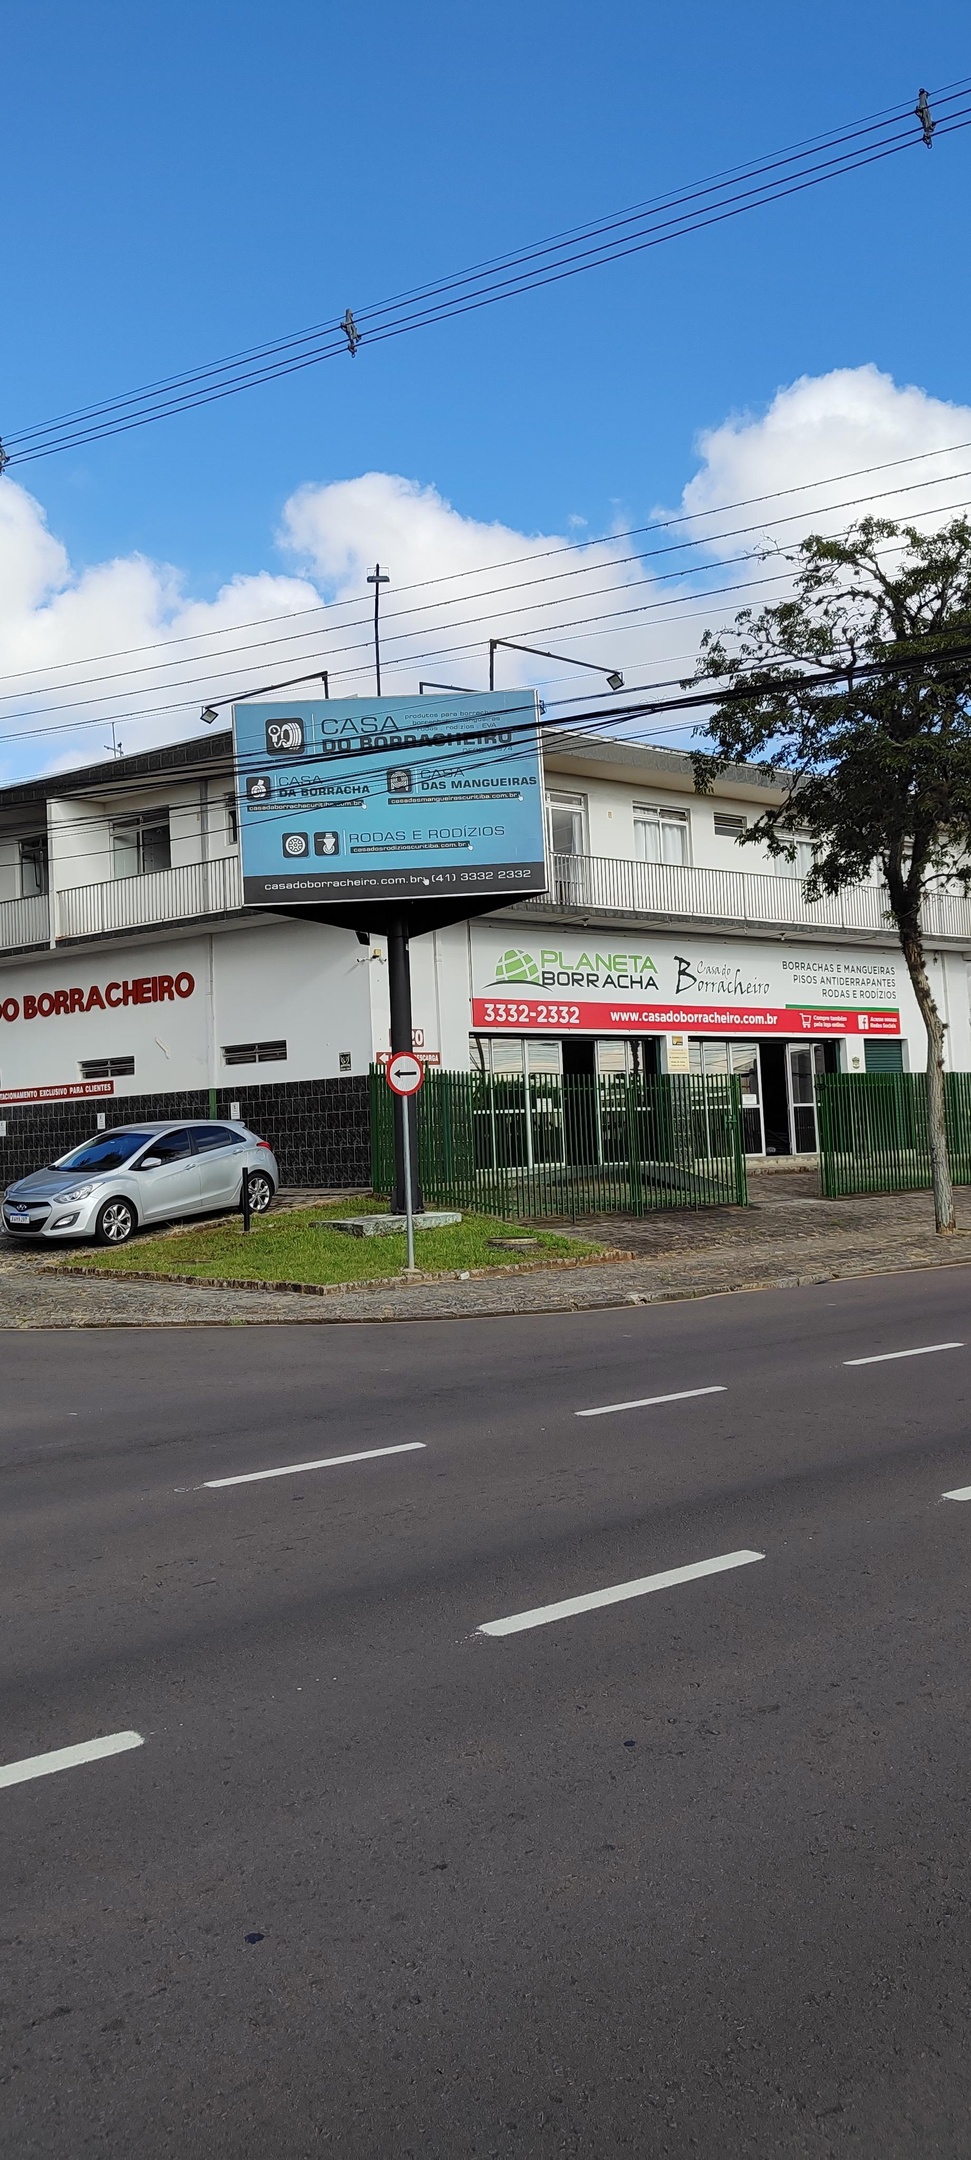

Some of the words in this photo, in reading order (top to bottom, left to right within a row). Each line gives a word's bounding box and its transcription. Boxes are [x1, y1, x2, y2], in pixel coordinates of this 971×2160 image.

[321, 716, 399, 735] CASA
[322, 738, 351, 753] DO
[420, 767, 465, 779] CASA
[279, 775, 323, 787] CASA
[421, 781, 446, 791] DAS
[451, 776, 537, 789] MANGUEIRAS
[279, 788, 297, 798] DA
[301, 785, 370, 797] BORRACHA
[349, 830, 406, 843] RODAS
[413, 830, 422, 840] E
[428, 825, 505, 839] RODÍZIOS
[264, 875, 423, 891] casadoborracheiro.com.br
[431, 873, 457, 884] (41)
[460, 871, 494, 881] 3332
[498, 869, 531, 879] 2332
[540, 950, 659, 974] PLANETA
[697, 960, 720, 975] Casa
[782, 960, 835, 973] BORRACHAS
[836, 964, 842, 973] E
[844, 965, 896, 975] MANGUEIRAS
[541, 971, 659, 990] BORRACHA
[673, 955, 770, 996] Borracheiro
[793, 974, 818, 985] PISOS
[820, 976, 896, 988] ANTIDERRAPANTES
[0, 998, 20, 1022] O
[23, 971, 196, 1020] BORRACHEIRO
[822, 988, 851, 999] RODAS
[852, 989, 858, 999] E
[859, 988, 897, 1000] RODÍZIOS
[484, 1003, 581, 1024] 3332-2332
[610, 1009, 778, 1026] www.casadoborracheiro.com.br
[40, 1087, 68, 1097] EXCLUSIVO
[69, 1086, 84, 1095] PARA
[85, 1083, 111, 1093] CLIENTES
